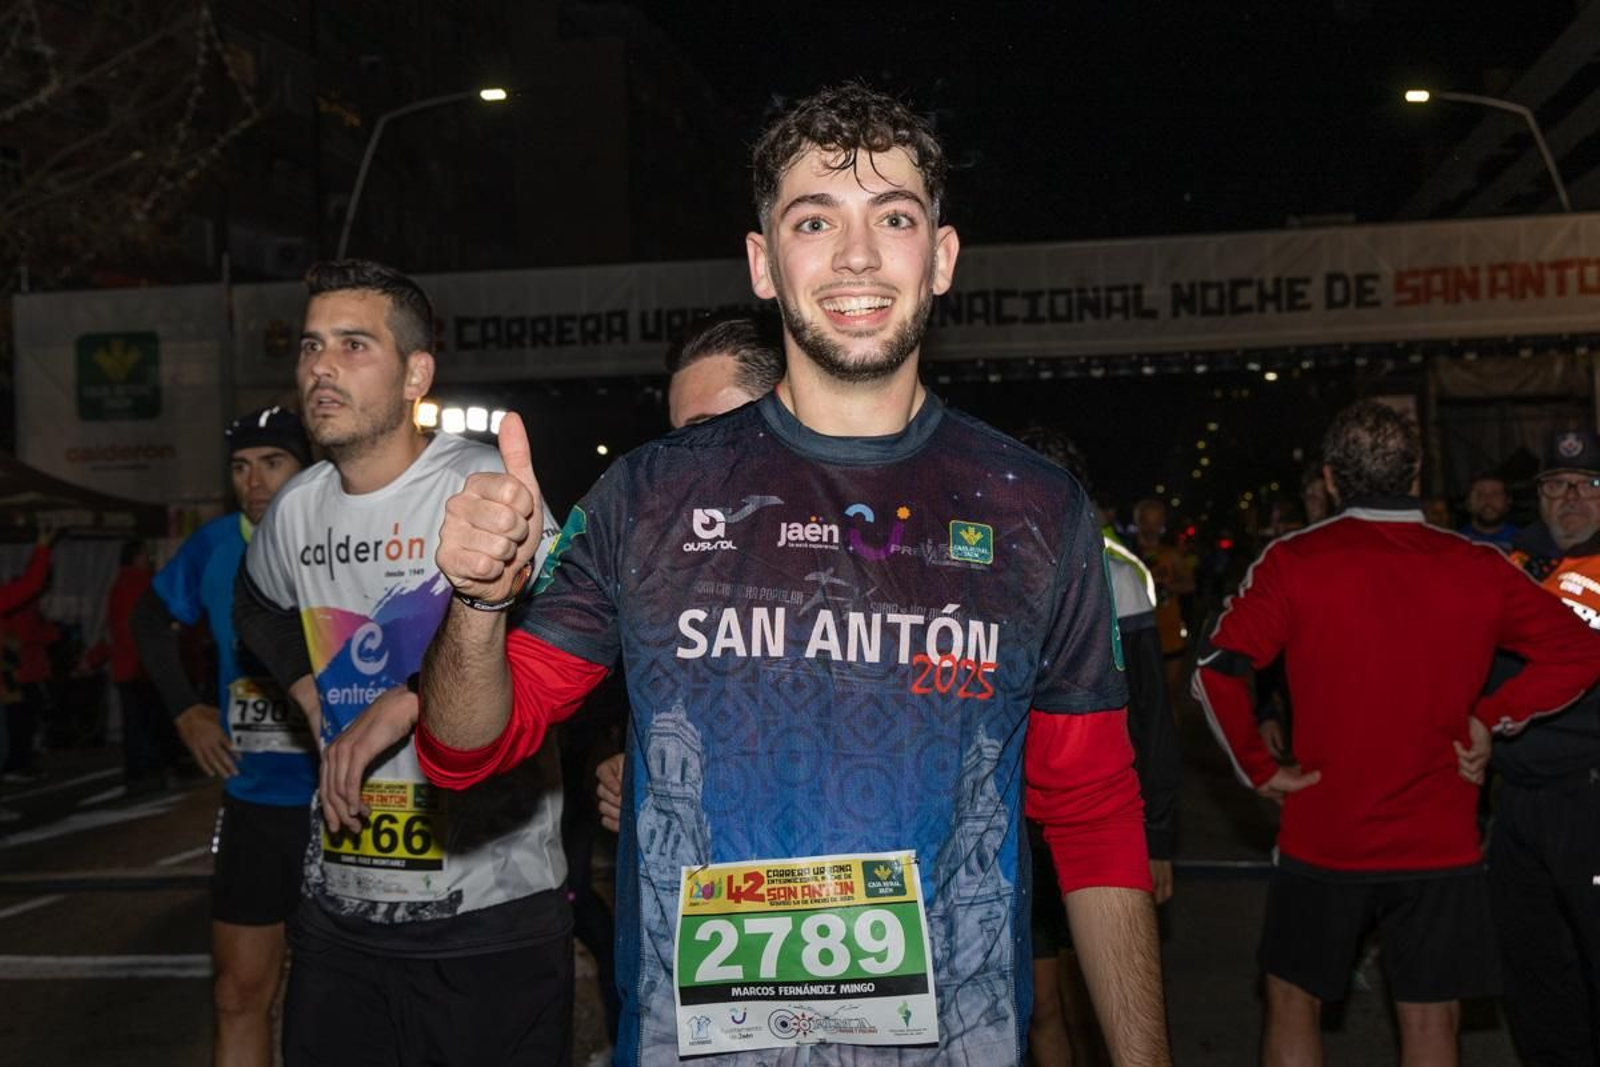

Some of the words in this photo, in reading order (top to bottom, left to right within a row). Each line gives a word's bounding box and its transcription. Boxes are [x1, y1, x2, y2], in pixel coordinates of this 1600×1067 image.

[454, 309, 628, 351] CARRERA
[929, 283, 1158, 327] NACIONAL
[1172, 277, 1311, 318] NOCHE
[1325, 273, 1382, 310] DE
[1394, 265, 1480, 307] SAN
[300, 522, 425, 581] calderón
[675, 606, 786, 660] SAN
[804, 602, 1000, 673] ANTÓN
[911, 653, 1000, 701] 2025
[726, 871, 766, 904] 42
[767, 868, 811, 878] CARRERA
[767, 886, 798, 902] SAN
[694, 909, 906, 982] 2789
[731, 985, 775, 999] MARCOS
[778, 982, 836, 996] FERNÁNDEZ
[840, 982, 875, 994] MINGO
